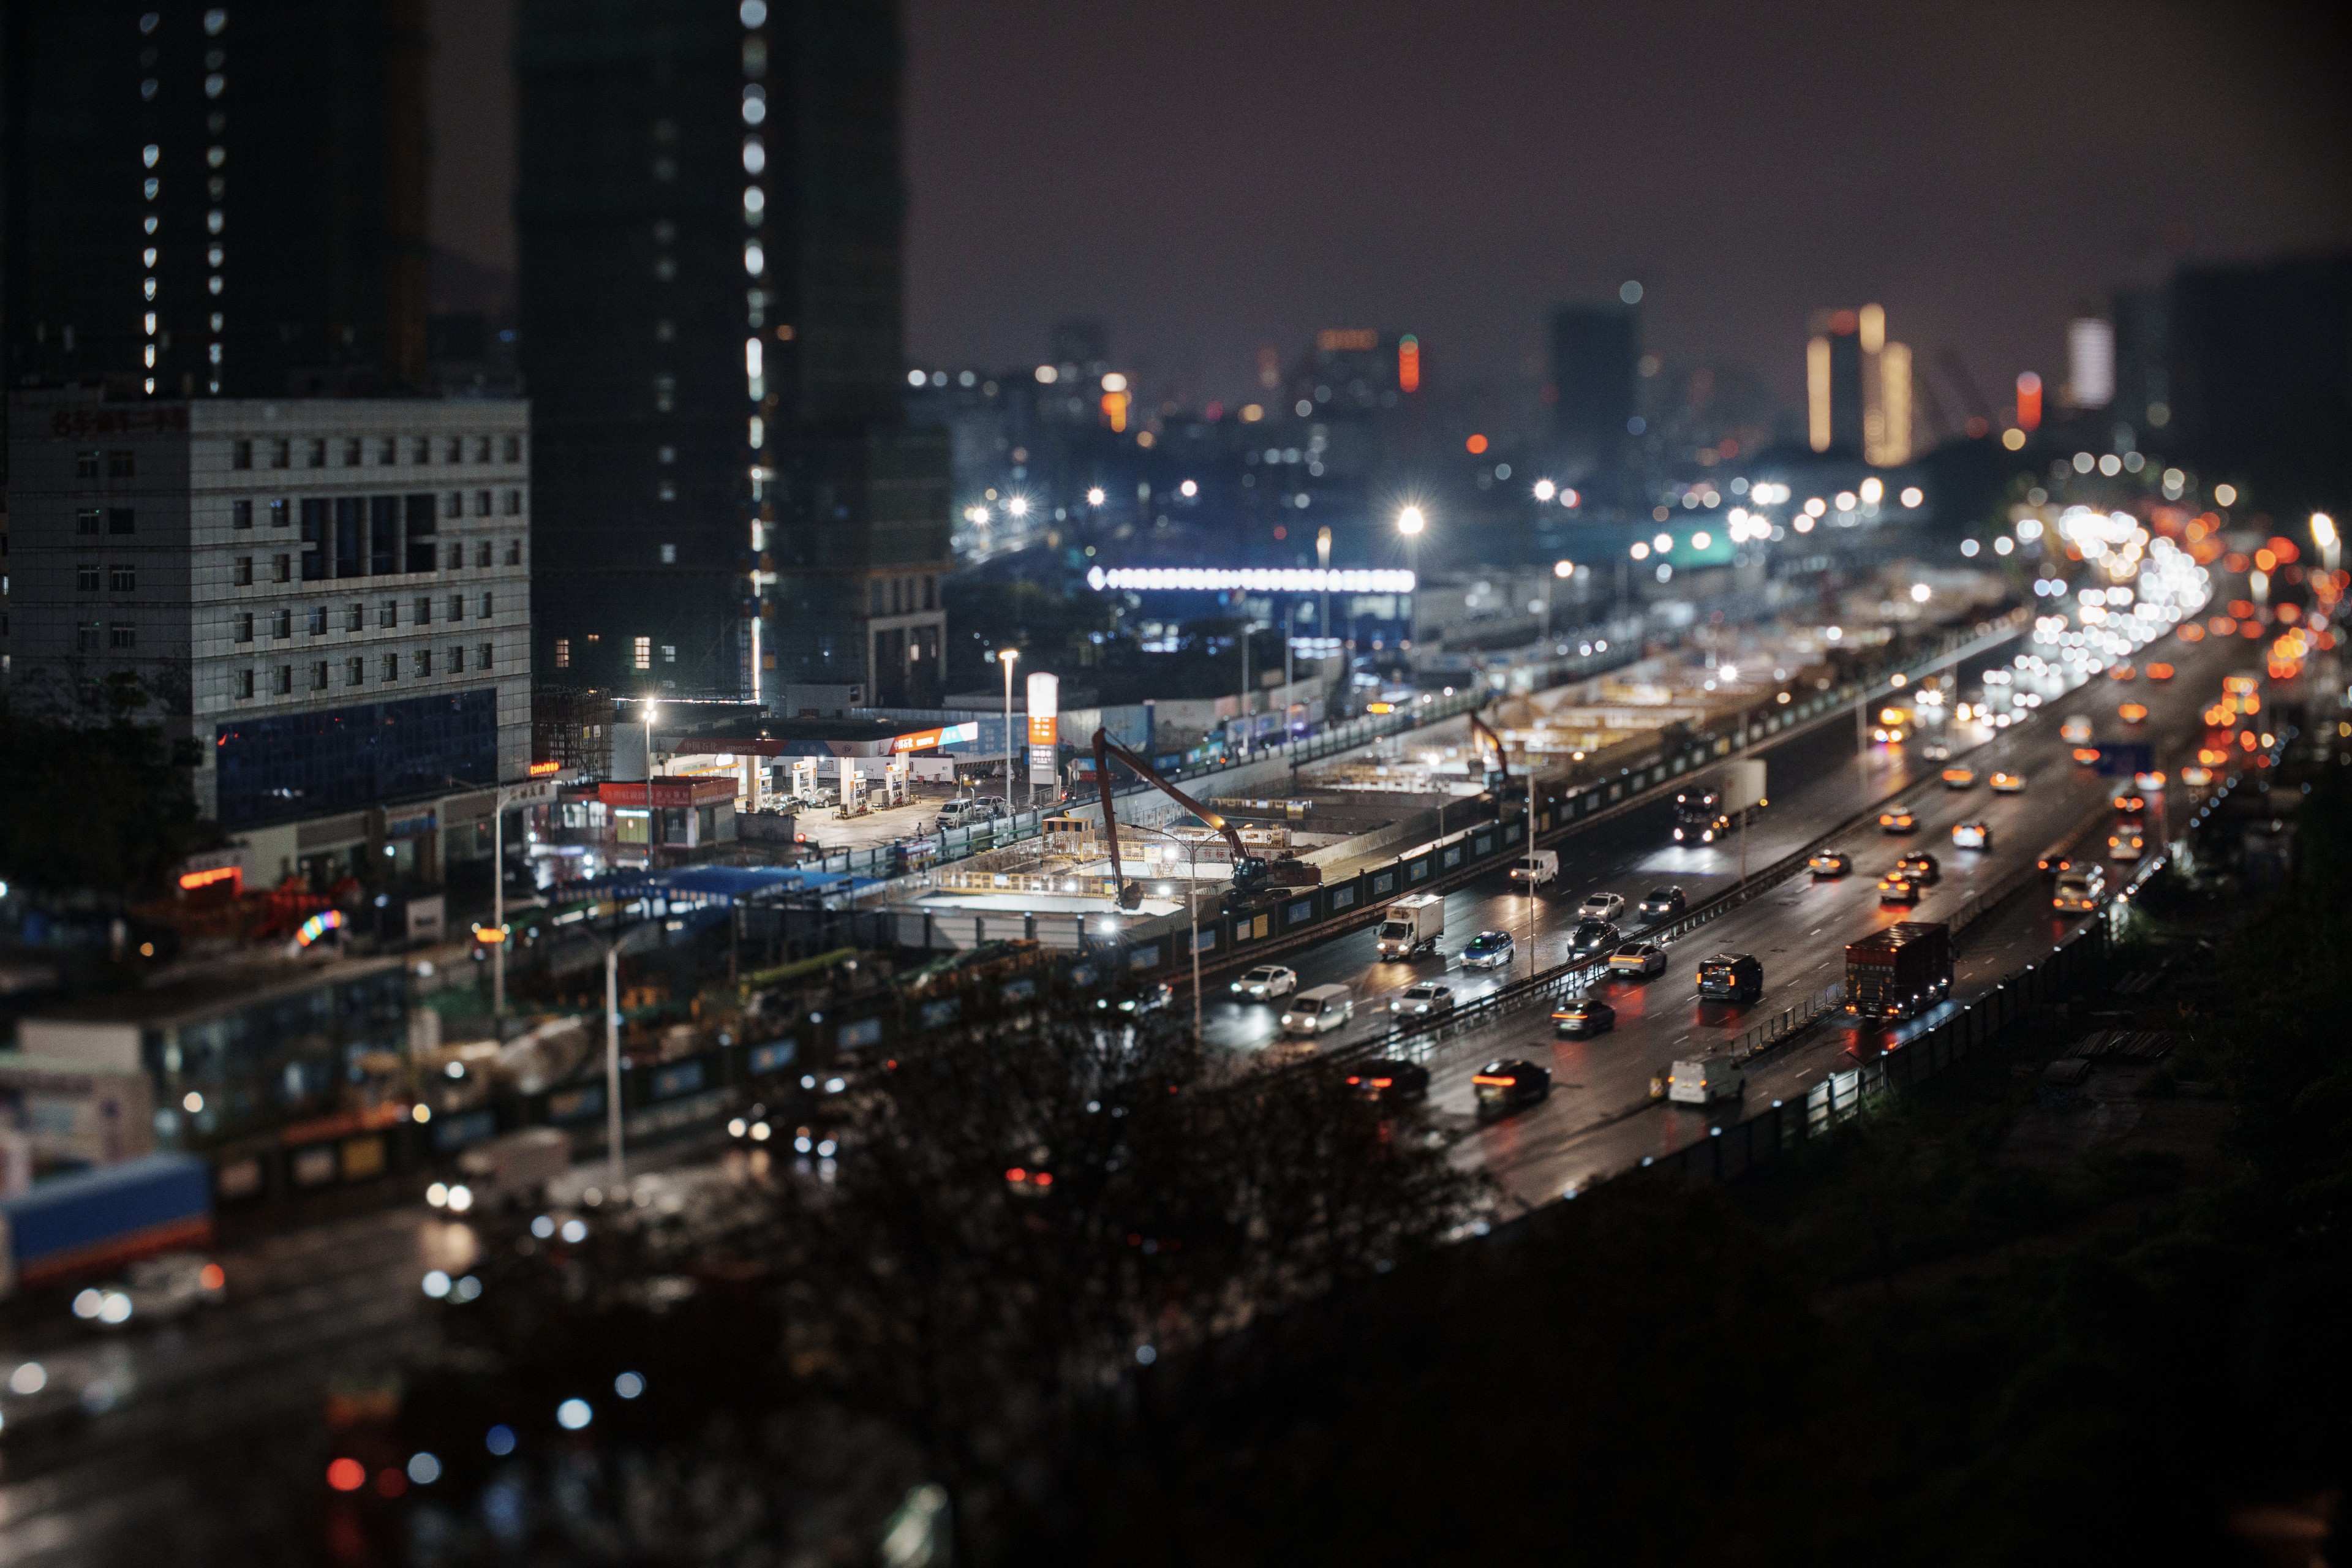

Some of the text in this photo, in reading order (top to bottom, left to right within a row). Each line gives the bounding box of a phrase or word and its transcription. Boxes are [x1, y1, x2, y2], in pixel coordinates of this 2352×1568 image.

[684, 741, 718, 752] 中国石化
[894, 737, 913, 750] 中国石化
